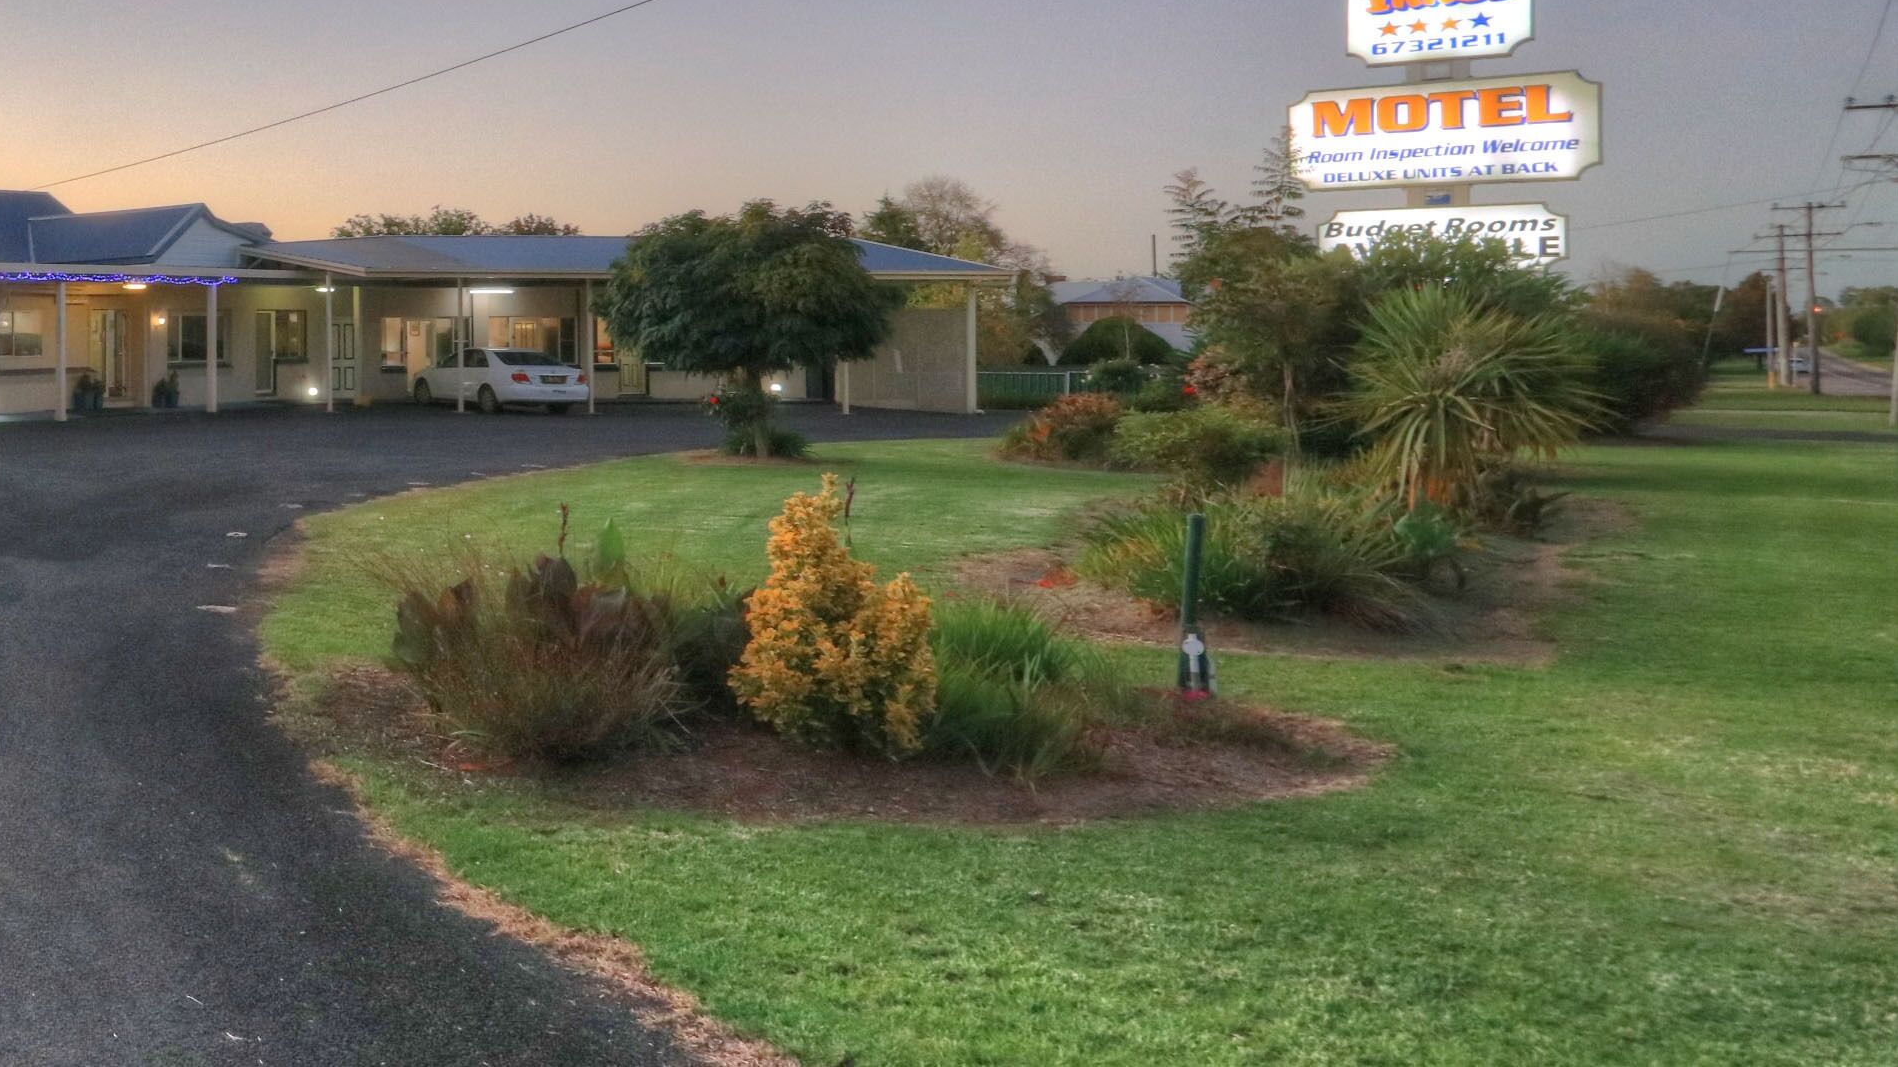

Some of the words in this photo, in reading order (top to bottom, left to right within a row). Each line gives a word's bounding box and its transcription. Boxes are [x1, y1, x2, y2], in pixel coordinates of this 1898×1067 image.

[1372, 32, 1505, 55] 67321211
[1311, 84, 1574, 138] MOTEL
[1308, 151, 1363, 164] Room
[1370, 143, 1475, 161] Inspection
[1483, 138, 1580, 153] Welcome
[1323, 169, 1398, 183] DELUXE
[1403, 166, 1463, 179] UNITS
[1469, 164, 1495, 176] AT
[1502, 161, 1559, 175] BACK
[1324, 219, 1438, 239] Budget
[1445, 217, 1557, 234] Rooms
